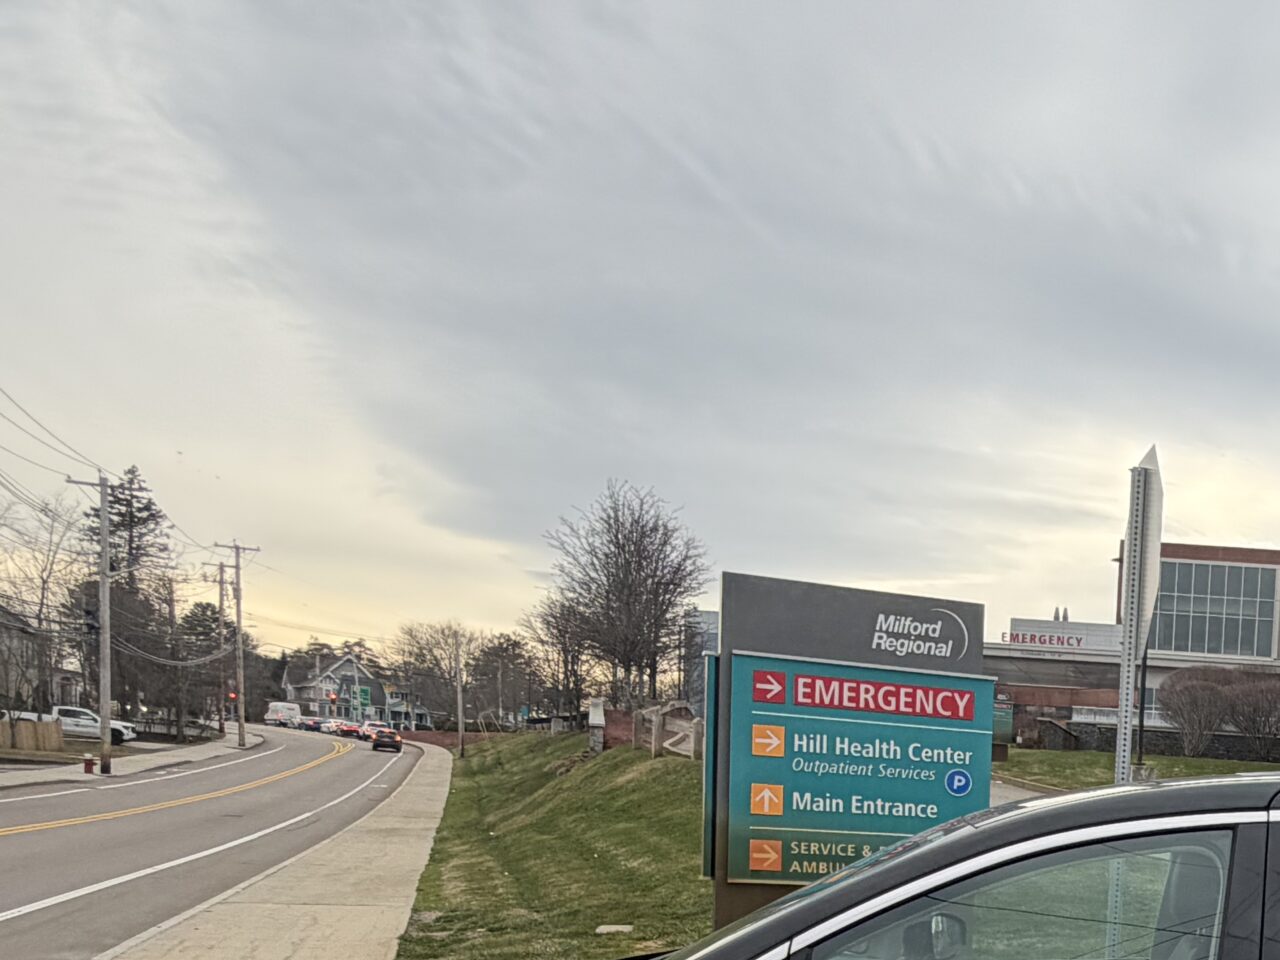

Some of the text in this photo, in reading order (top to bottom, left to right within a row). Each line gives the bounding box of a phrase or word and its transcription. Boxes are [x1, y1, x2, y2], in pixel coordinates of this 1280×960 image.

[875, 613, 942, 638] Milford
[871, 631, 953, 657] Regional
[1001, 632, 1083, 647] EMERGENCY
[797, 677, 971, 717] EMERGENCY
[793, 733, 973, 765] Hill Health Center
[792, 757, 936, 781] Outpatient Services
[953, 775, 966, 790] P
[792, 792, 938, 818] Main Entrance
[790, 841, 856, 857] SERVICE
[862, 845, 872, 858] &
